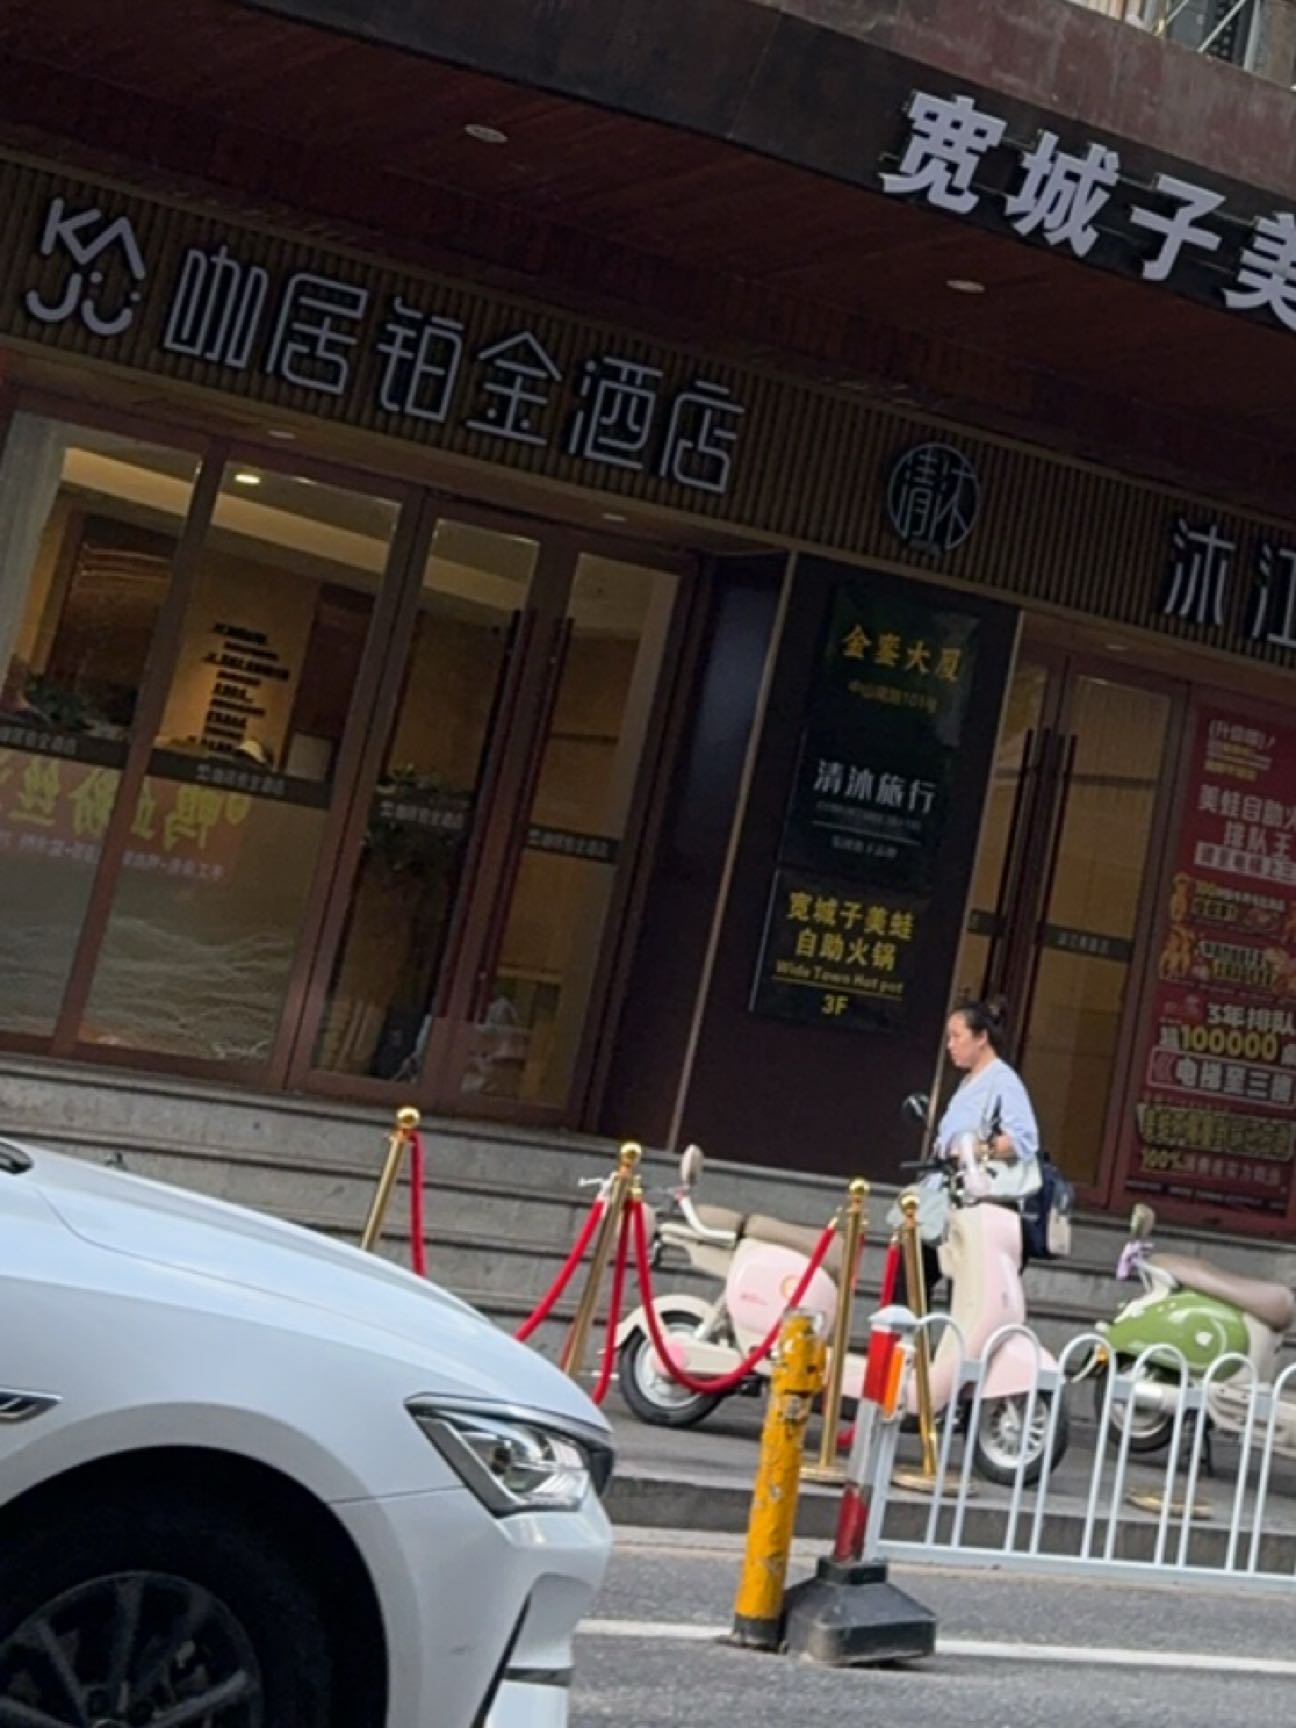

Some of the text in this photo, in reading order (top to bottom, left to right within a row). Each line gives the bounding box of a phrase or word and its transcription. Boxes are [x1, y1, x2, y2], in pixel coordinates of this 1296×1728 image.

[164, 245, 745, 494] 咖居铂金酒店
[795, 928, 897, 972] 自助火锅
